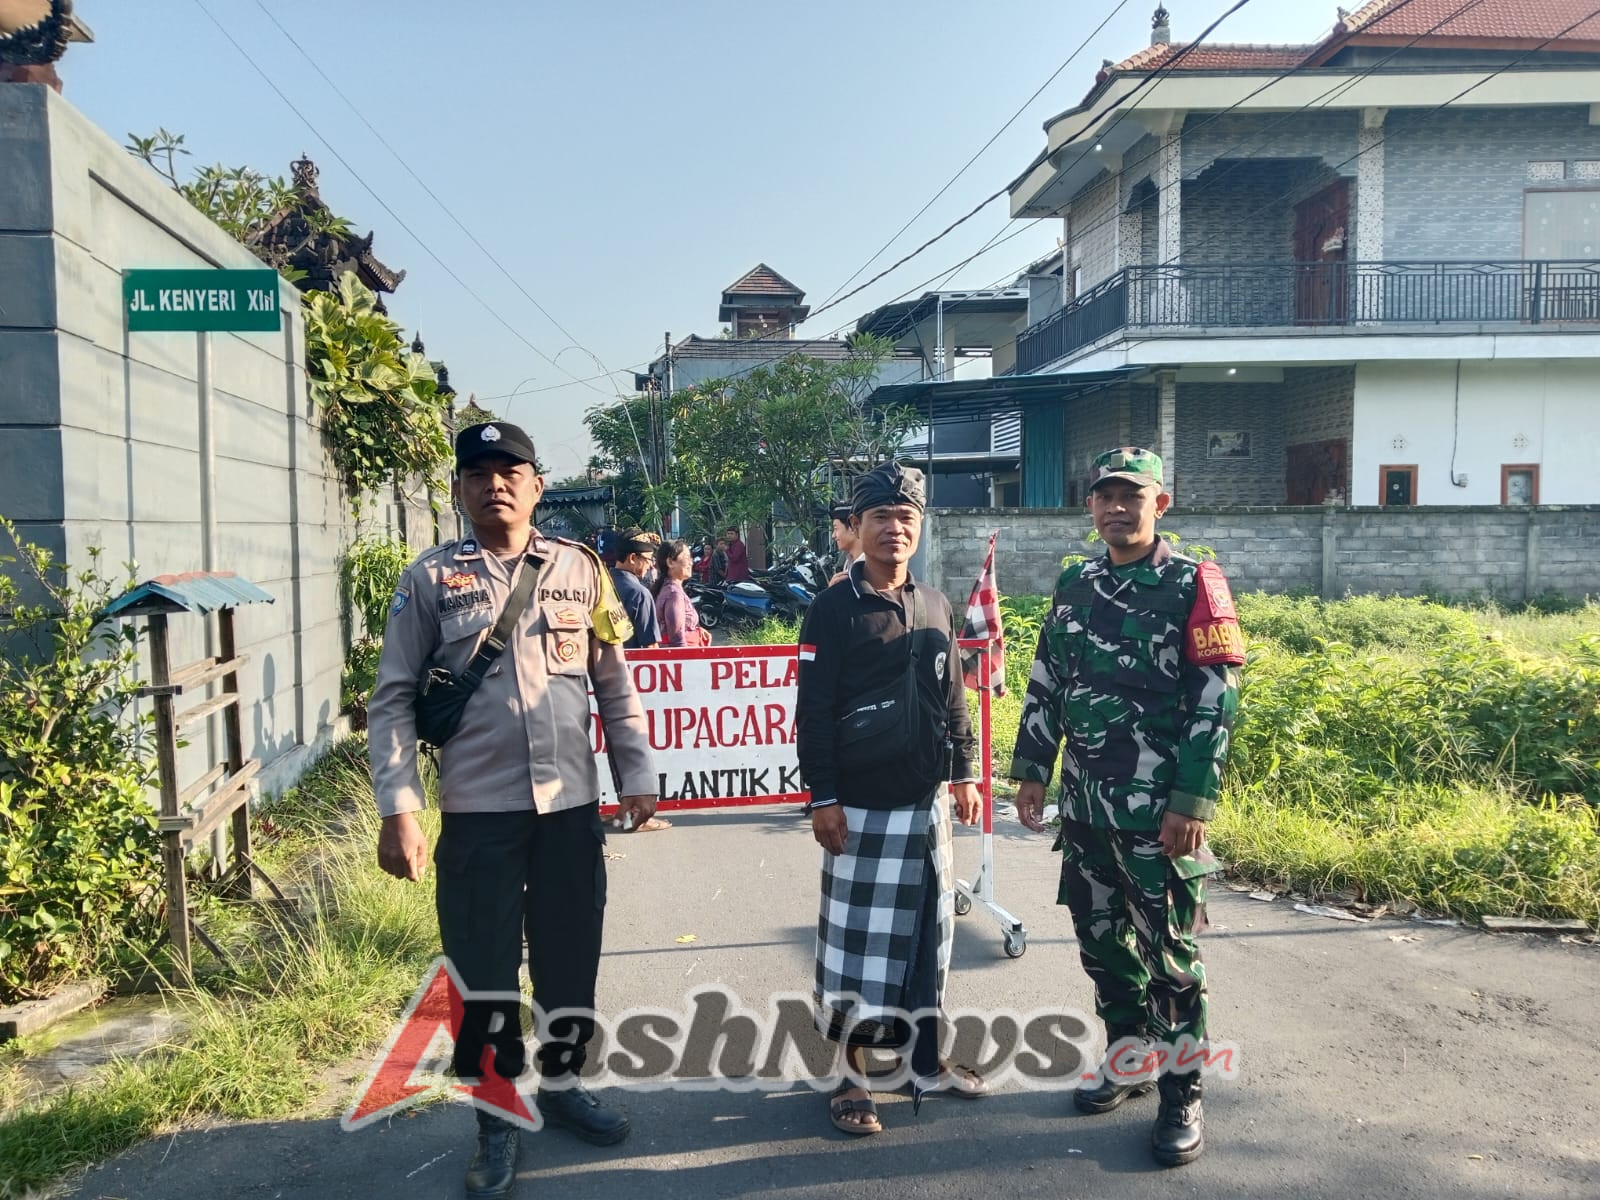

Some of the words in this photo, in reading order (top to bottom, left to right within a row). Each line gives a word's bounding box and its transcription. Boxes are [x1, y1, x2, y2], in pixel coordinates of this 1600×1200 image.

[130, 289, 155, 312] JL.
[159, 289, 236, 312] KENYERI
[540, 589, 586, 603] POLRI
